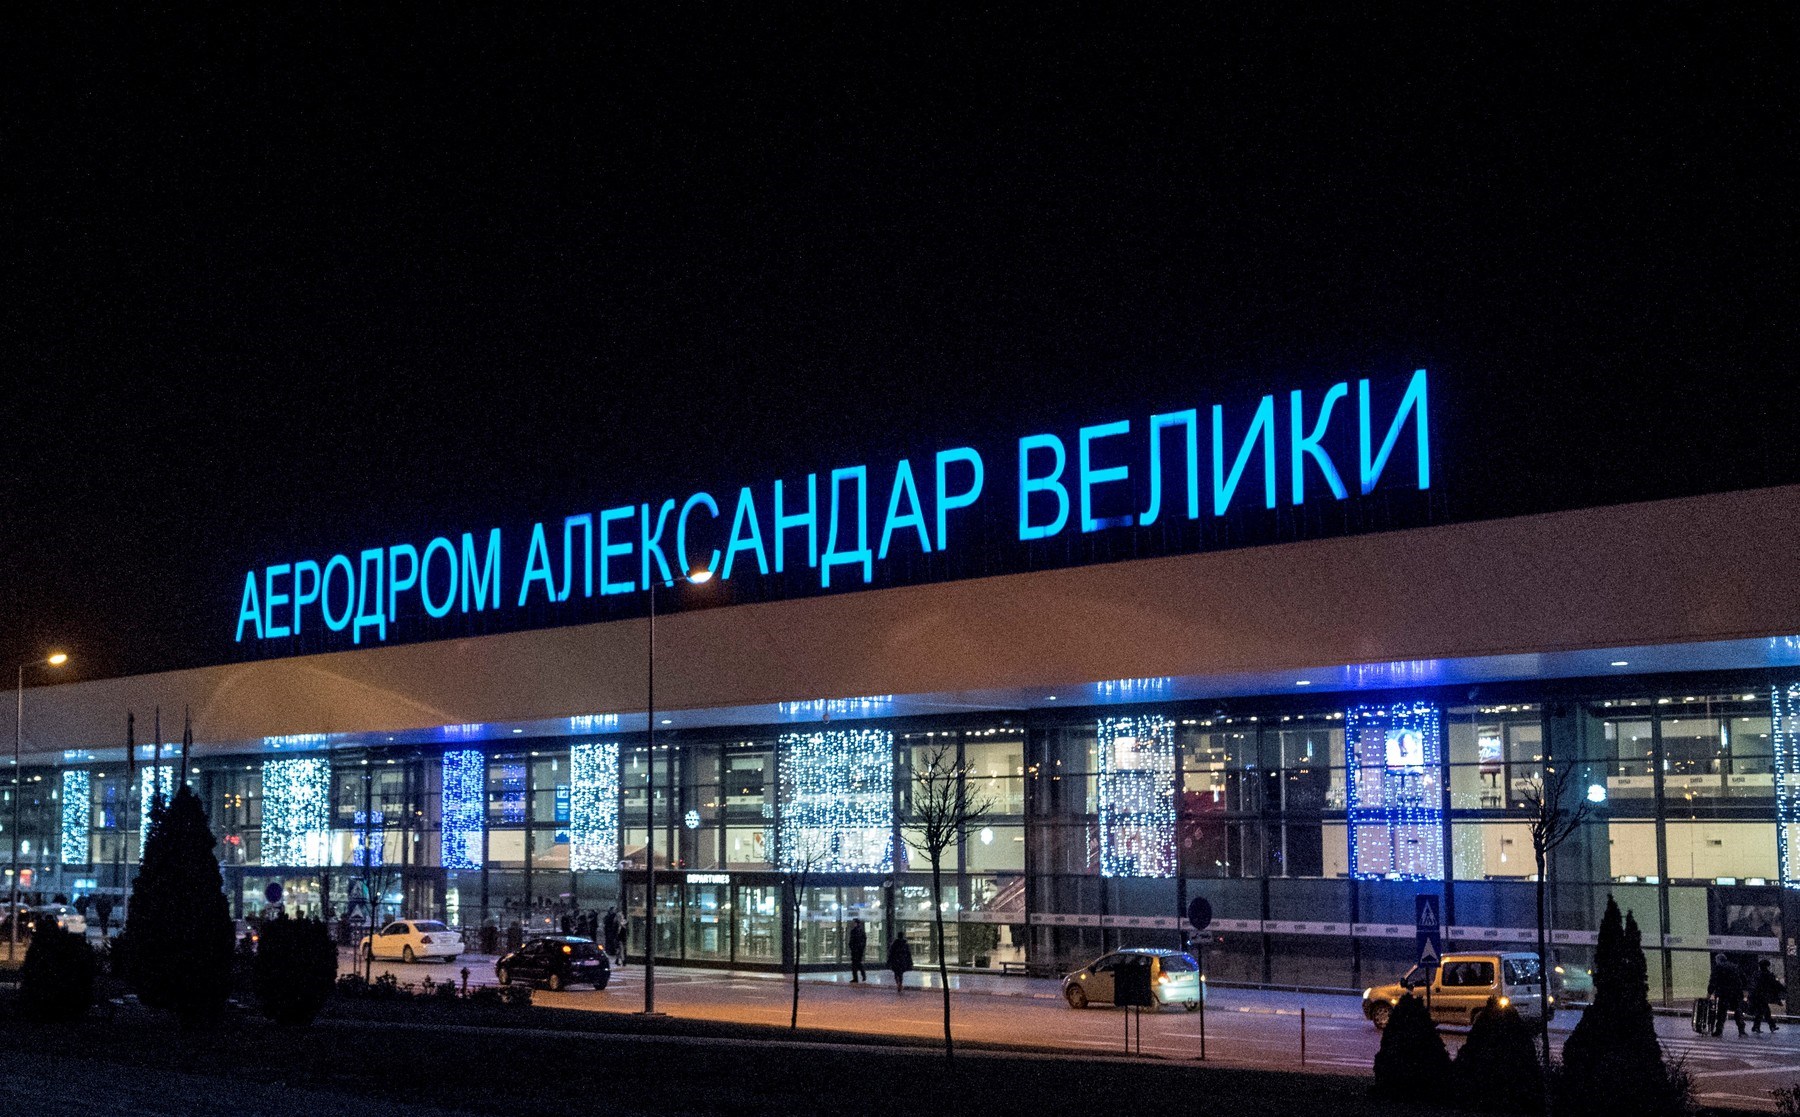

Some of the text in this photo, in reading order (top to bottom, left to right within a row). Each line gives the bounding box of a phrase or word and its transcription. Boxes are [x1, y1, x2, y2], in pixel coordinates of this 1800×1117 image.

[235, 368, 1431, 645] АЕРОДРОМ АЛЕКСАНДАР ВЕЛИКИ
[687, 874, 730, 884] DEPARTURES
